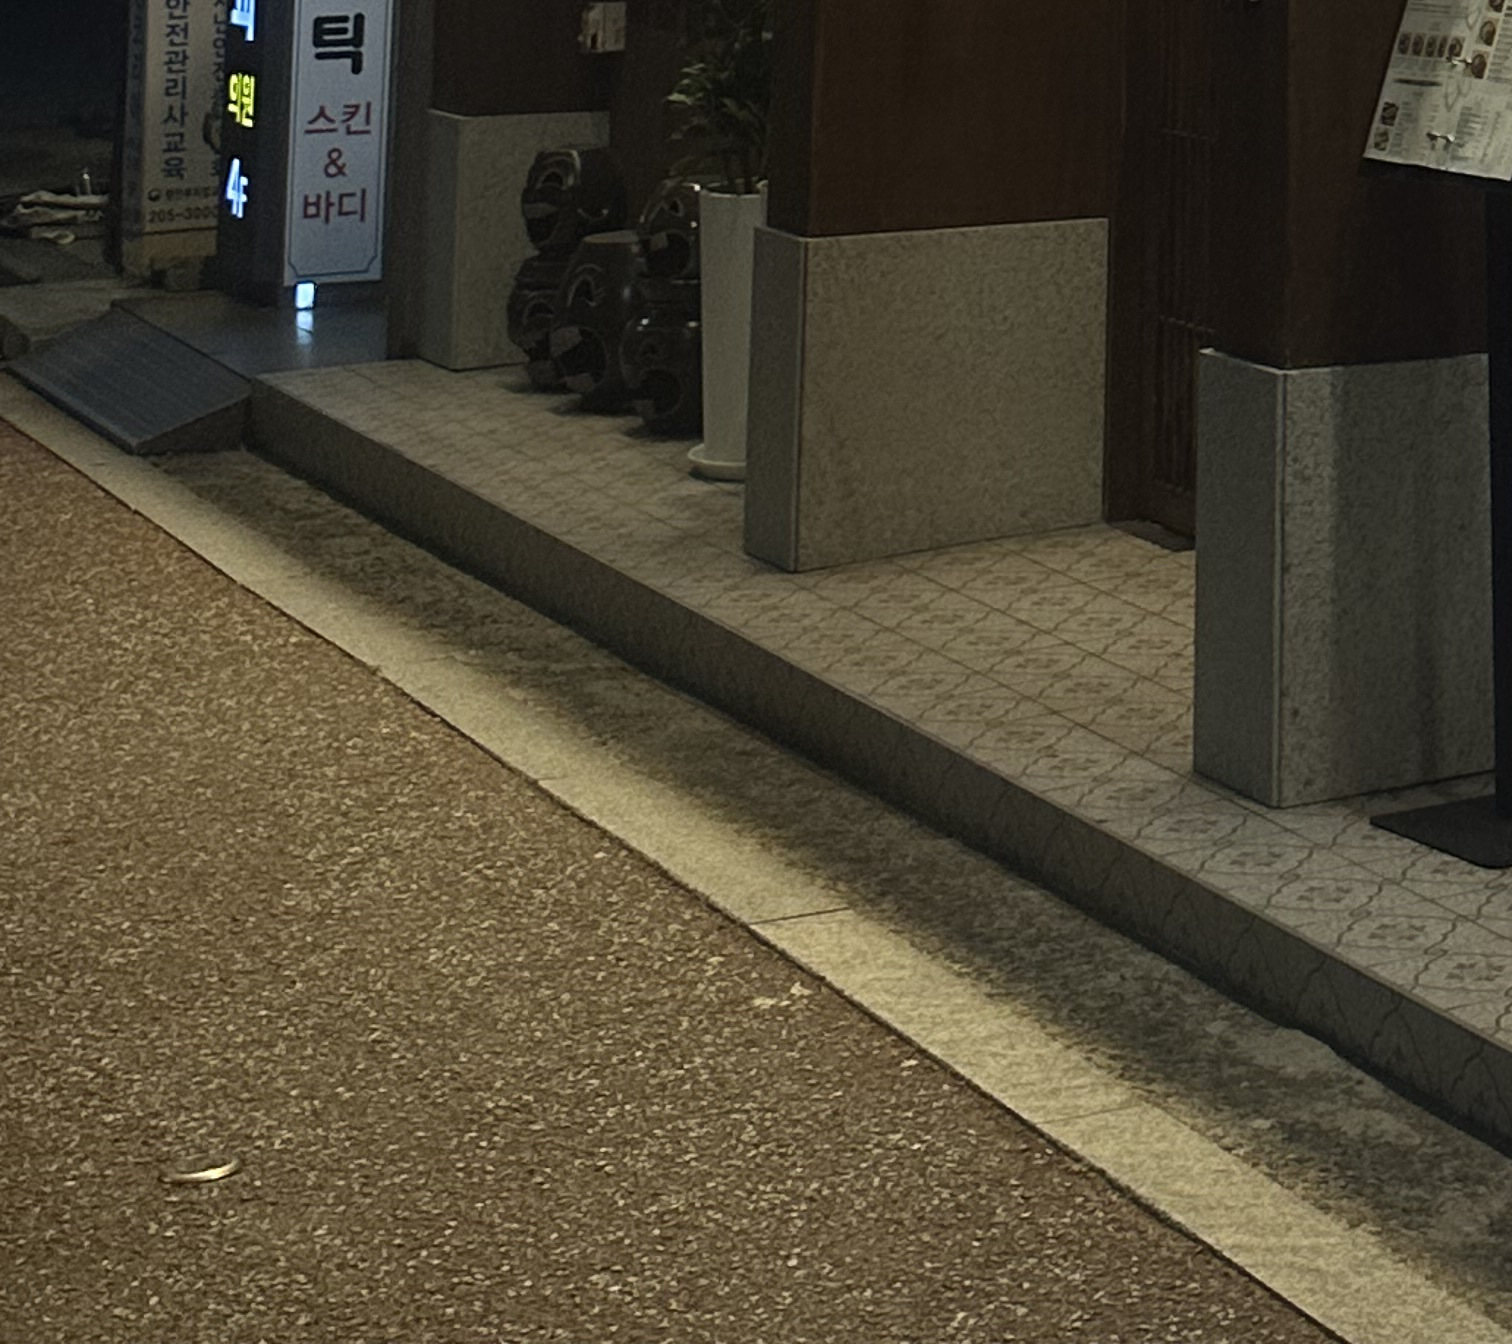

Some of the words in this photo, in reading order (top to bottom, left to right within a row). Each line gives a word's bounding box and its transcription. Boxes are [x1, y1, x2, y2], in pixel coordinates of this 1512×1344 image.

[303, 102, 372, 137] 스킨
[323, 148, 348, 179] &
[302, 188, 368, 225] 바디
